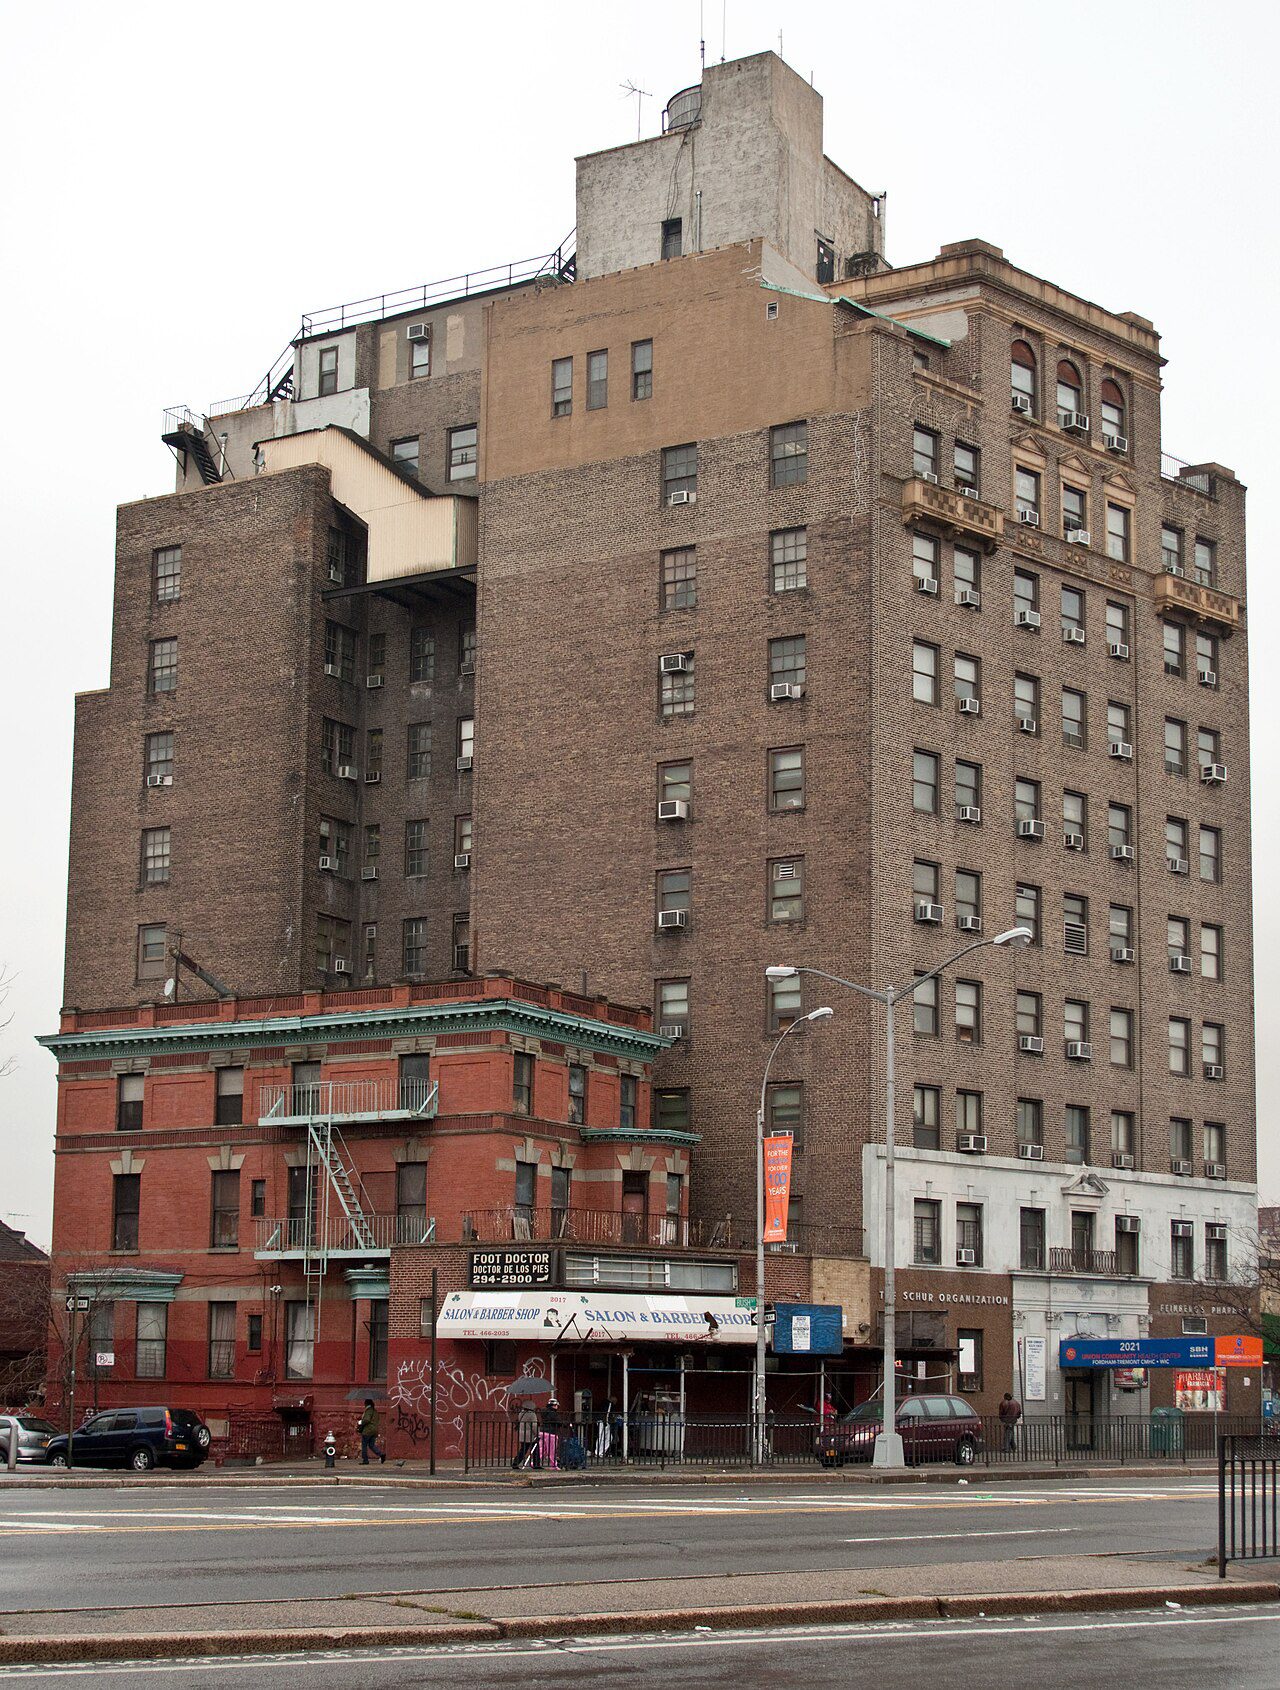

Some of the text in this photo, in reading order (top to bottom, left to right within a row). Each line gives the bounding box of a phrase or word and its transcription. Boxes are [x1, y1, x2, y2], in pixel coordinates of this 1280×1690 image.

[769, 1171, 787, 1186] 100
[473, 1253, 549, 1264] FOOT DOCTOR
[473, 1264, 549, 1274] DOCTOR DE LOS PIES
[472, 1274, 533, 1284] 294-2900
[903, 1291, 934, 1302] SCHUR
[939, 1293, 1008, 1305] ORGANIZATION
[443, 1308, 541, 1320] SALON & BARBER SHOP
[584, 1310, 637, 1323] SALON
[640, 1312, 649, 1322] &
[713, 1313, 751, 1325] SHOP
[1119, 1342, 1141, 1351] 2021
